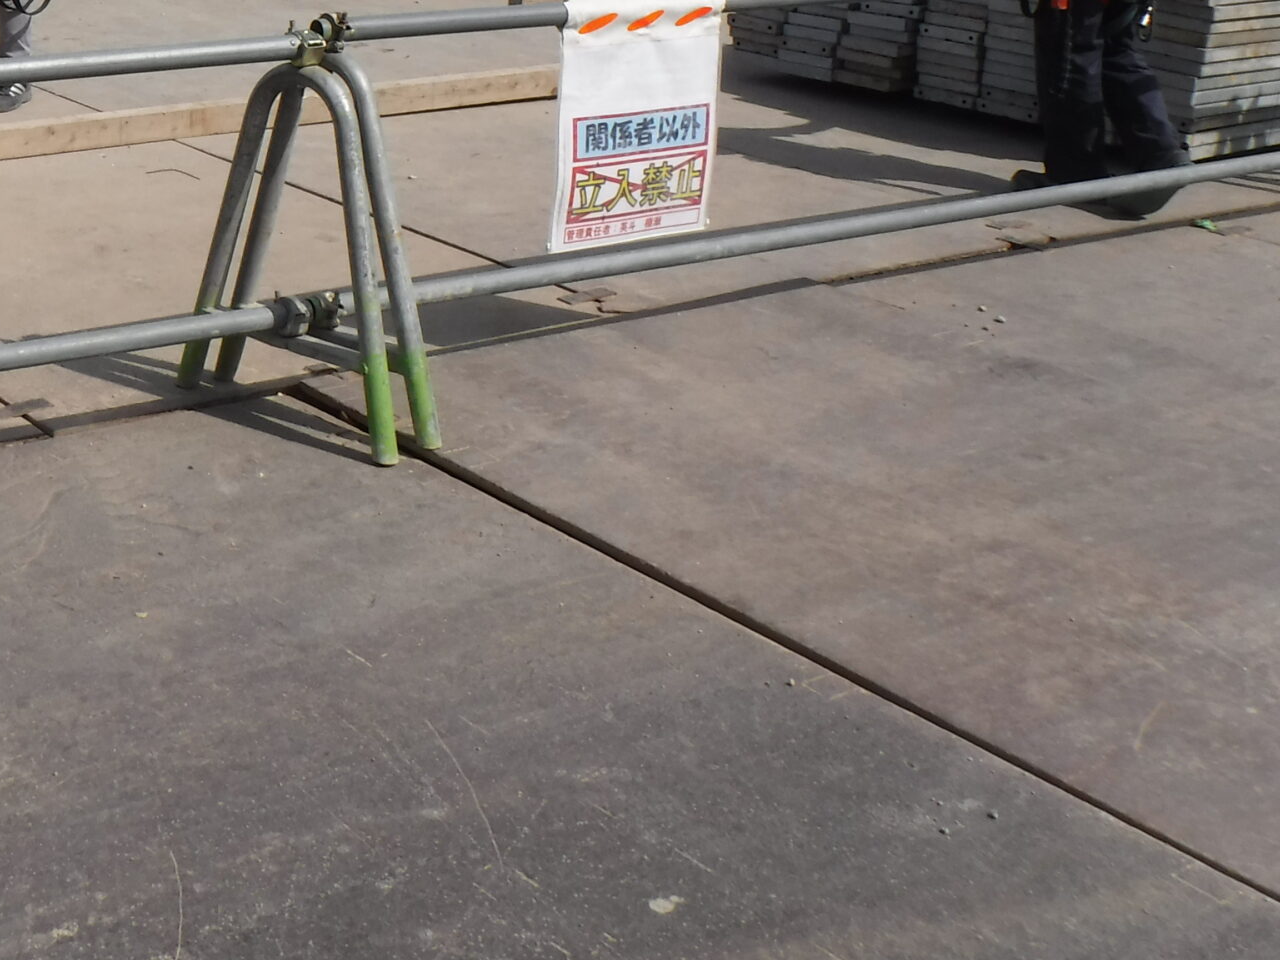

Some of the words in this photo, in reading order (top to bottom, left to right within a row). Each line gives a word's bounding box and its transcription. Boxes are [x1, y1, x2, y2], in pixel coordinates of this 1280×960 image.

[585, 111, 701, 153] 関係者以外
[572, 159, 702, 215] 立入禁止
